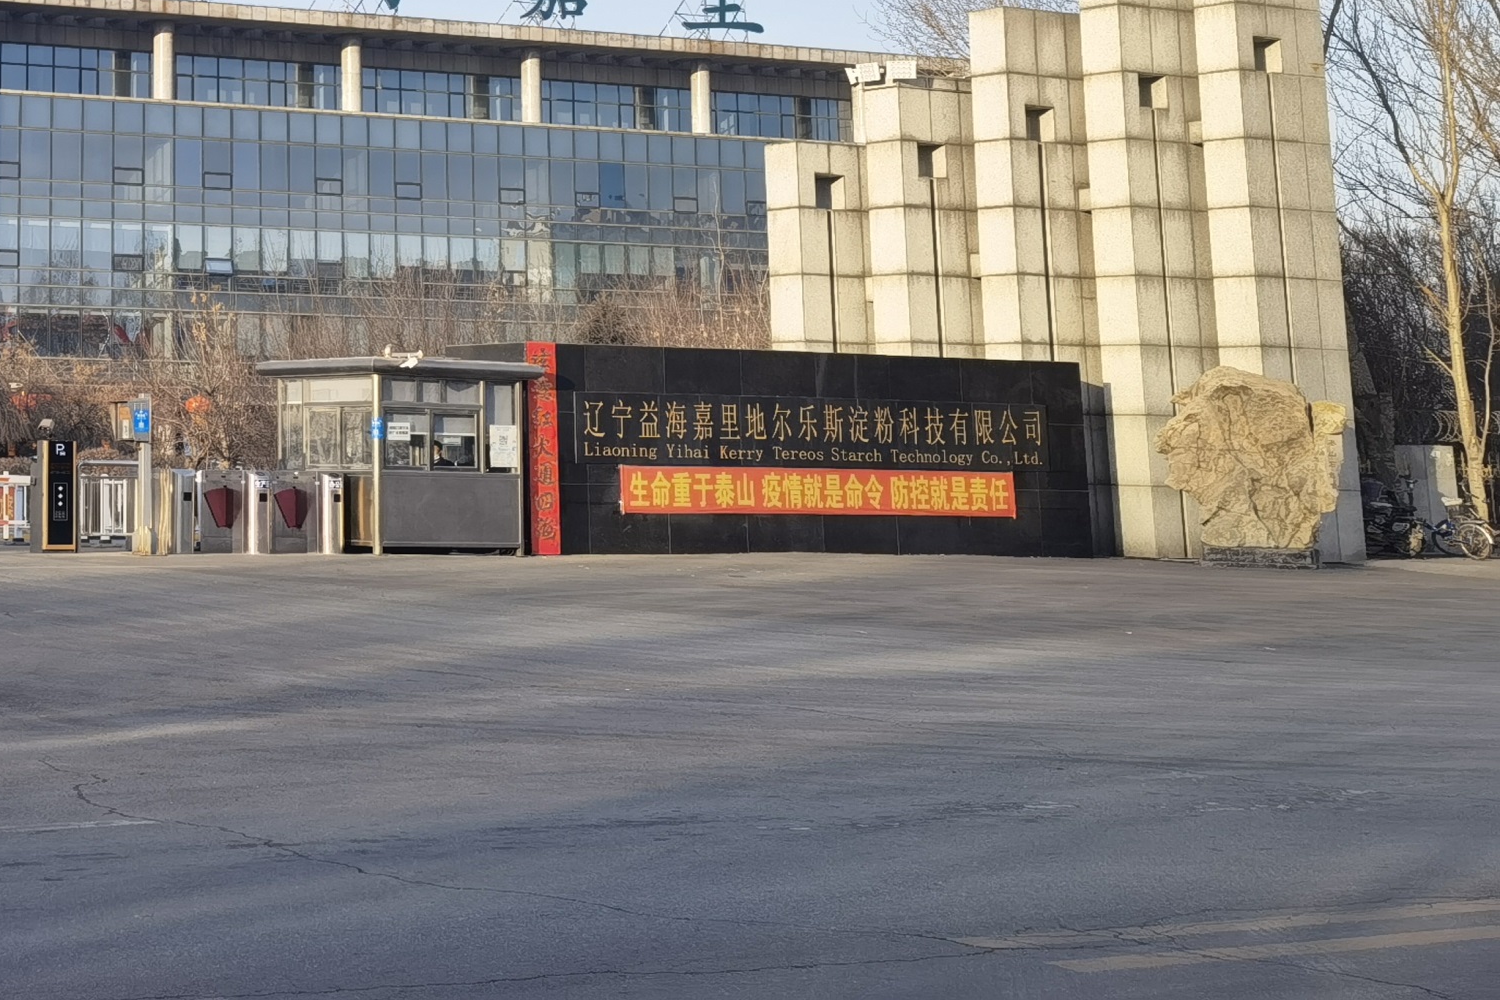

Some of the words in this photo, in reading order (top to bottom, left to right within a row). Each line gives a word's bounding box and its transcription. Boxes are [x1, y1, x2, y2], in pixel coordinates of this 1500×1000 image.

[583, 399, 1041, 446] 辽宁益海嘉里地尔乐斯淀粉科技有限公司
[583, 442, 657, 460] Liaoning
[666, 443, 710, 459] Yihai
[719, 445, 764, 461] Kerry
[772, 446, 824, 461] Tereos
[831, 447, 883, 462] Starch
[890, 448, 973, 465] Technology
[629, 471, 755, 508] 生命重于泰山
[762, 472, 884, 510] 疫情就是命令
[890, 475, 1009, 511] 防控就是责任
